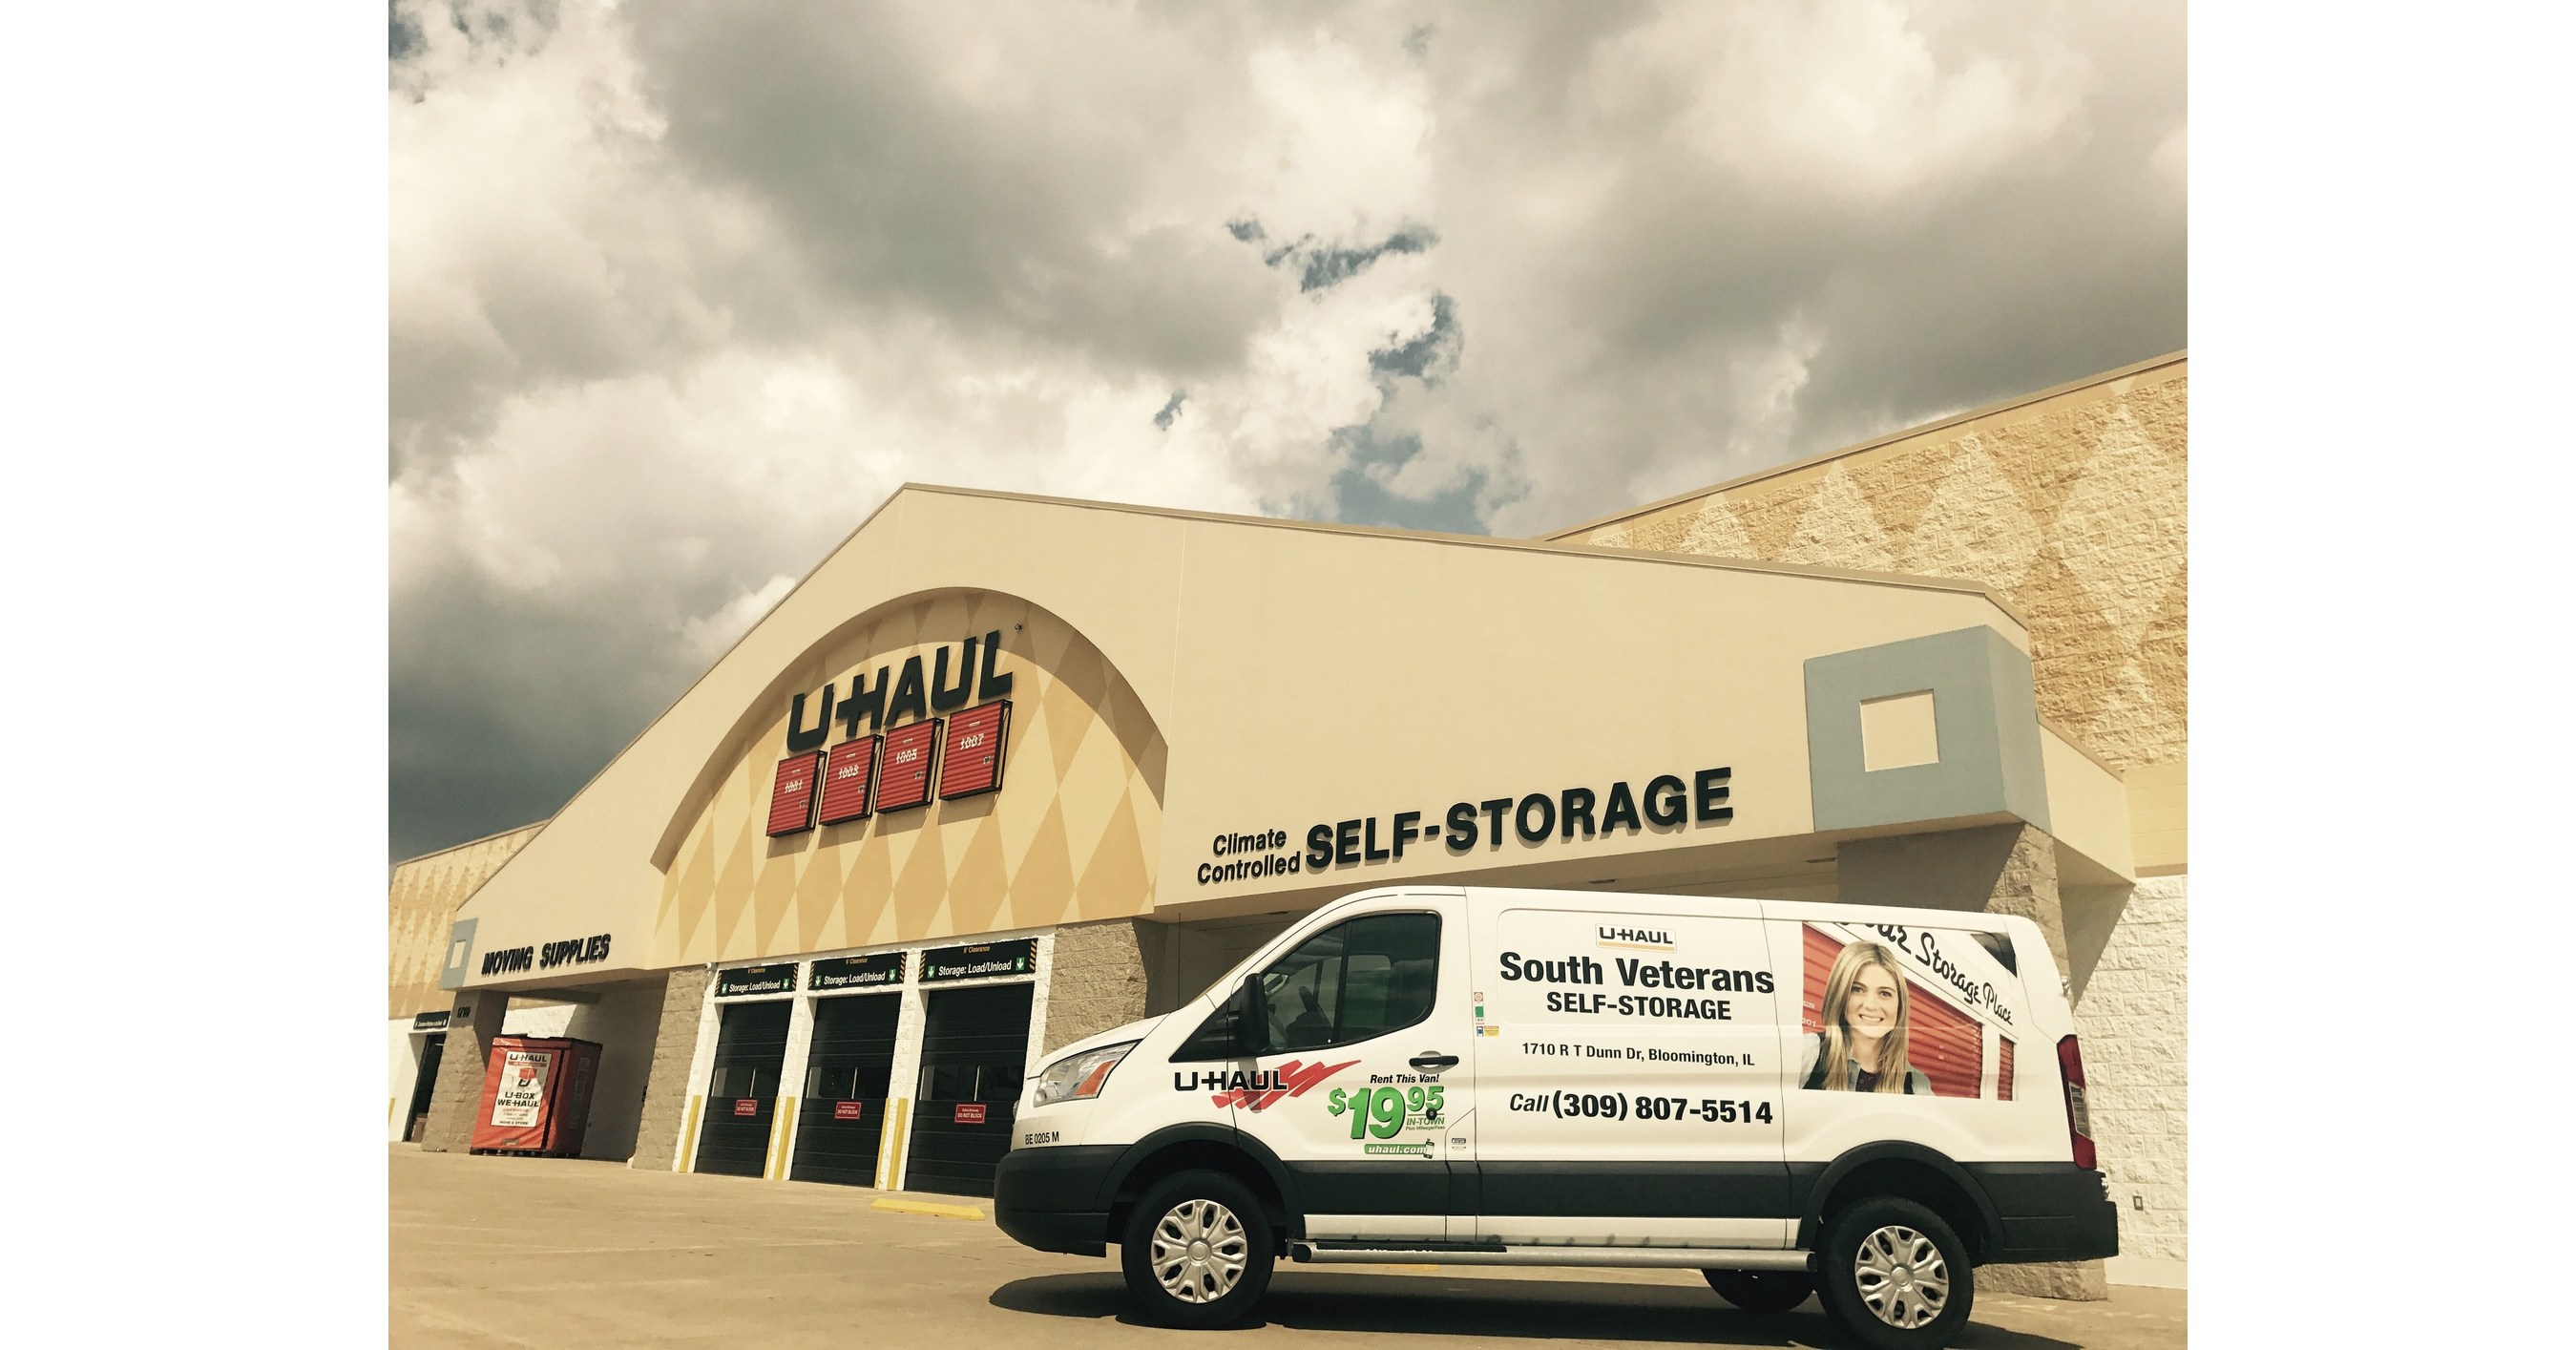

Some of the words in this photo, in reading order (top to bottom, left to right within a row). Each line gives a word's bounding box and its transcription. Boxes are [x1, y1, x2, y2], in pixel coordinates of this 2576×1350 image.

[786, 629, 1014, 752] U-HAUL
[960, 732, 985, 750] 1007
[895, 749, 917, 764] 1005
[785, 779, 802, 794] 1001
[1305, 766, 1733, 870] SELF-STORAGE
[1212, 828, 1287, 856] Climate
[1197, 851, 1301, 884] Controlled
[1599, 926, 1673, 944] U-HAUL
[481, 946, 534, 976] MOVING
[539, 934, 612, 967] SUPPLIES
[938, 965, 967, 977] Storage:
[968, 960, 1012, 974] Load/Unload
[1499, 952, 1604, 984] South
[1616, 958, 1775, 994] Veterans
[729, 983, 748, 993] Storage:
[749, 980, 781, 991] Load/Unload
[824, 975, 848, 986] Storage:
[848, 971, 886, 983] Load/Unload
[1916, 932, 1981, 1004] Storage
[1982, 982, 2014, 1025] Place
[1546, 991, 1732, 1021] SELF-STORAGE
[509, 1053, 548, 1063] U-HAUL
[1522, 1043, 1556, 1056] 1710
[1560, 1044, 1569, 1056] R
[1573, 1044, 1582, 1057] T
[1586, 1045, 1622, 1060] Dunn
[1626, 1047, 1644, 1062] Dr,
[1648, 1048, 1739, 1067] Bloomington,
[1743, 1054, 1755, 1066] IL
[1174, 1070, 1287, 1091] U-HAUL
[1370, 1074, 1393, 1084] Rent
[1396, 1073, 1416, 1084] This
[1419, 1073, 1439, 1083] Van!
[497, 1099, 539, 1107] WE-HAUL
[1510, 1093, 1549, 1113] Call
[1552, 1090, 1628, 1121] (309)
[1635, 1097, 1773, 1125] 807-5514
[1406, 1117, 1445, 1126] IN-TOWN
[1025, 1134, 1034, 1145] BE
[1035, 1132, 1050, 1145] 0205
[1052, 1130, 1059, 1143] M
[1369, 1145, 1427, 1154] uhaul.com
